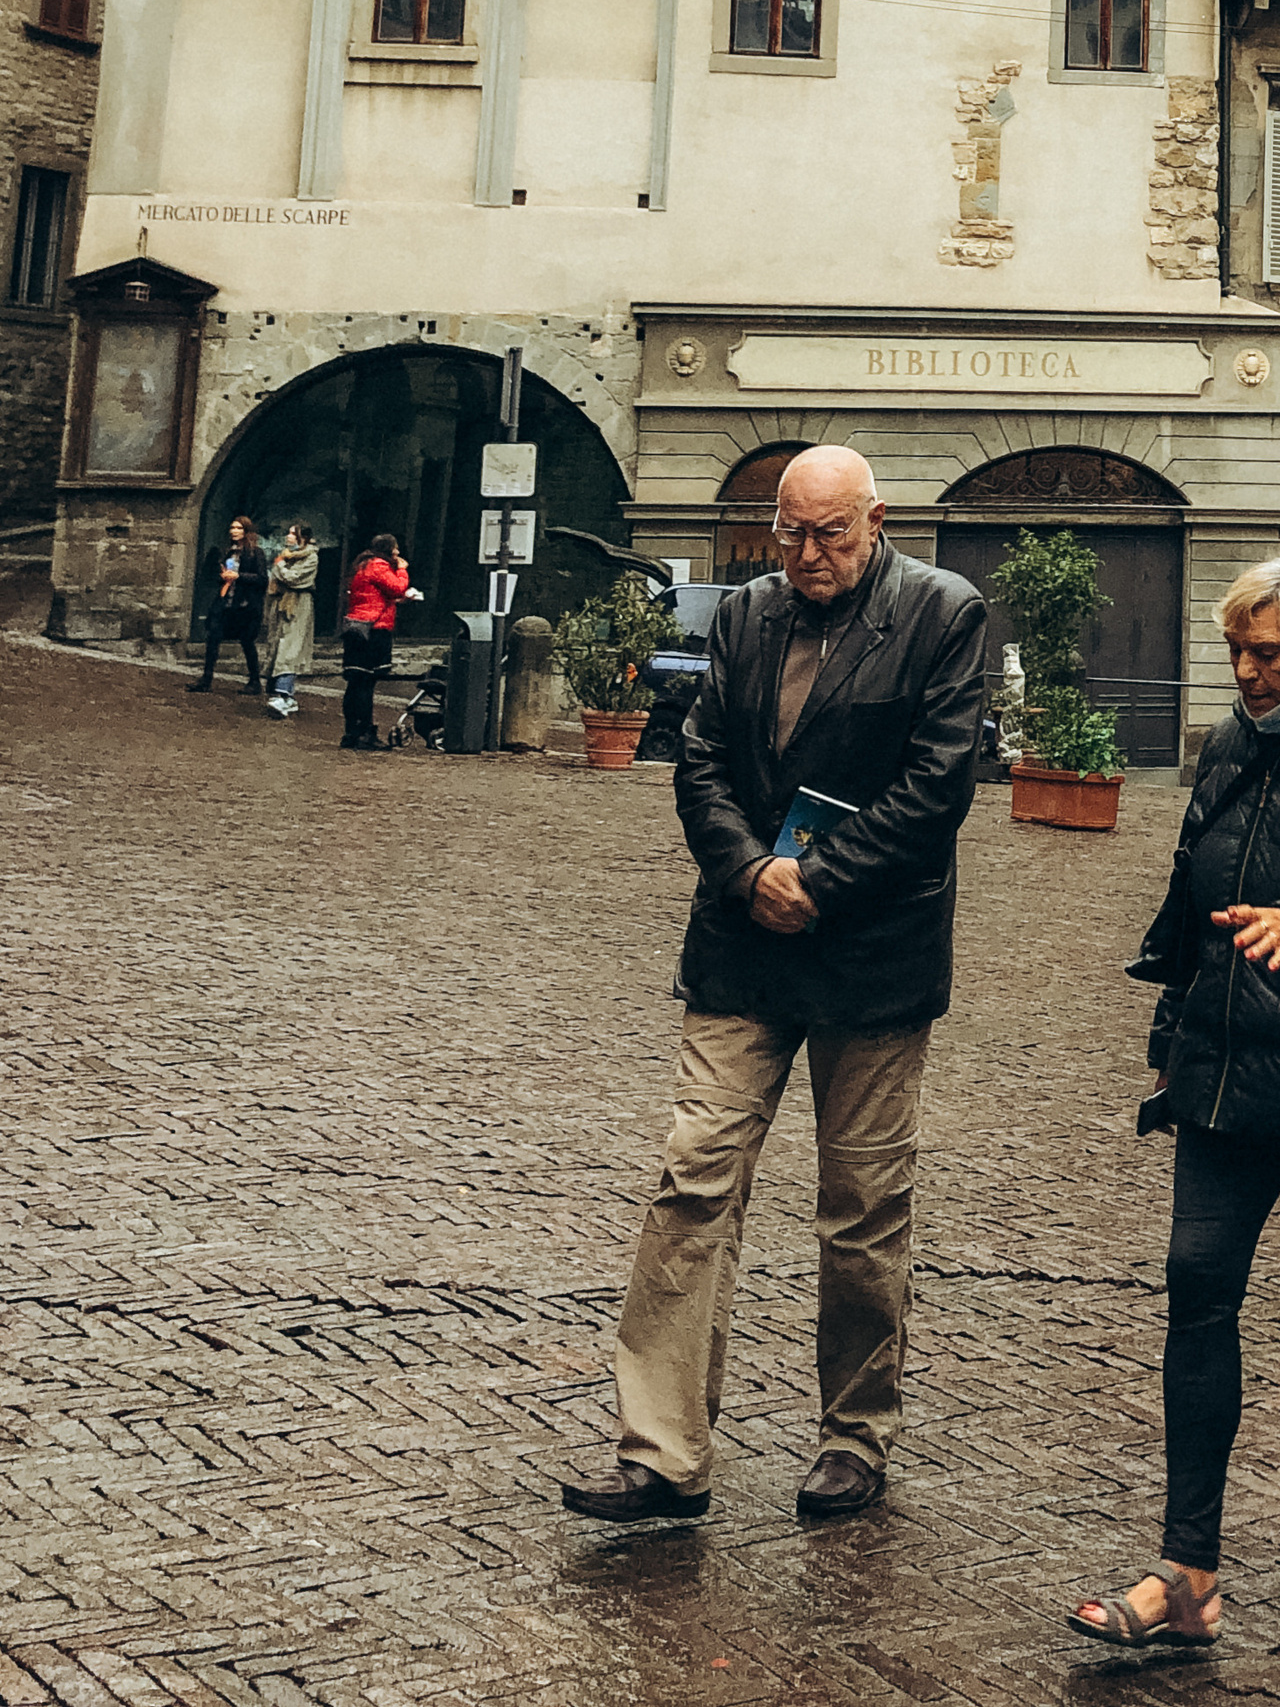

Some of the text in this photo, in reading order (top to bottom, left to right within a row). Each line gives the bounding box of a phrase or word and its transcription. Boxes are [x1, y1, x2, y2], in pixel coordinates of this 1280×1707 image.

[138, 204, 350, 225] MERCATO DELLE SCARPE
[866, 348, 1081, 378] BIBLIOTECA
